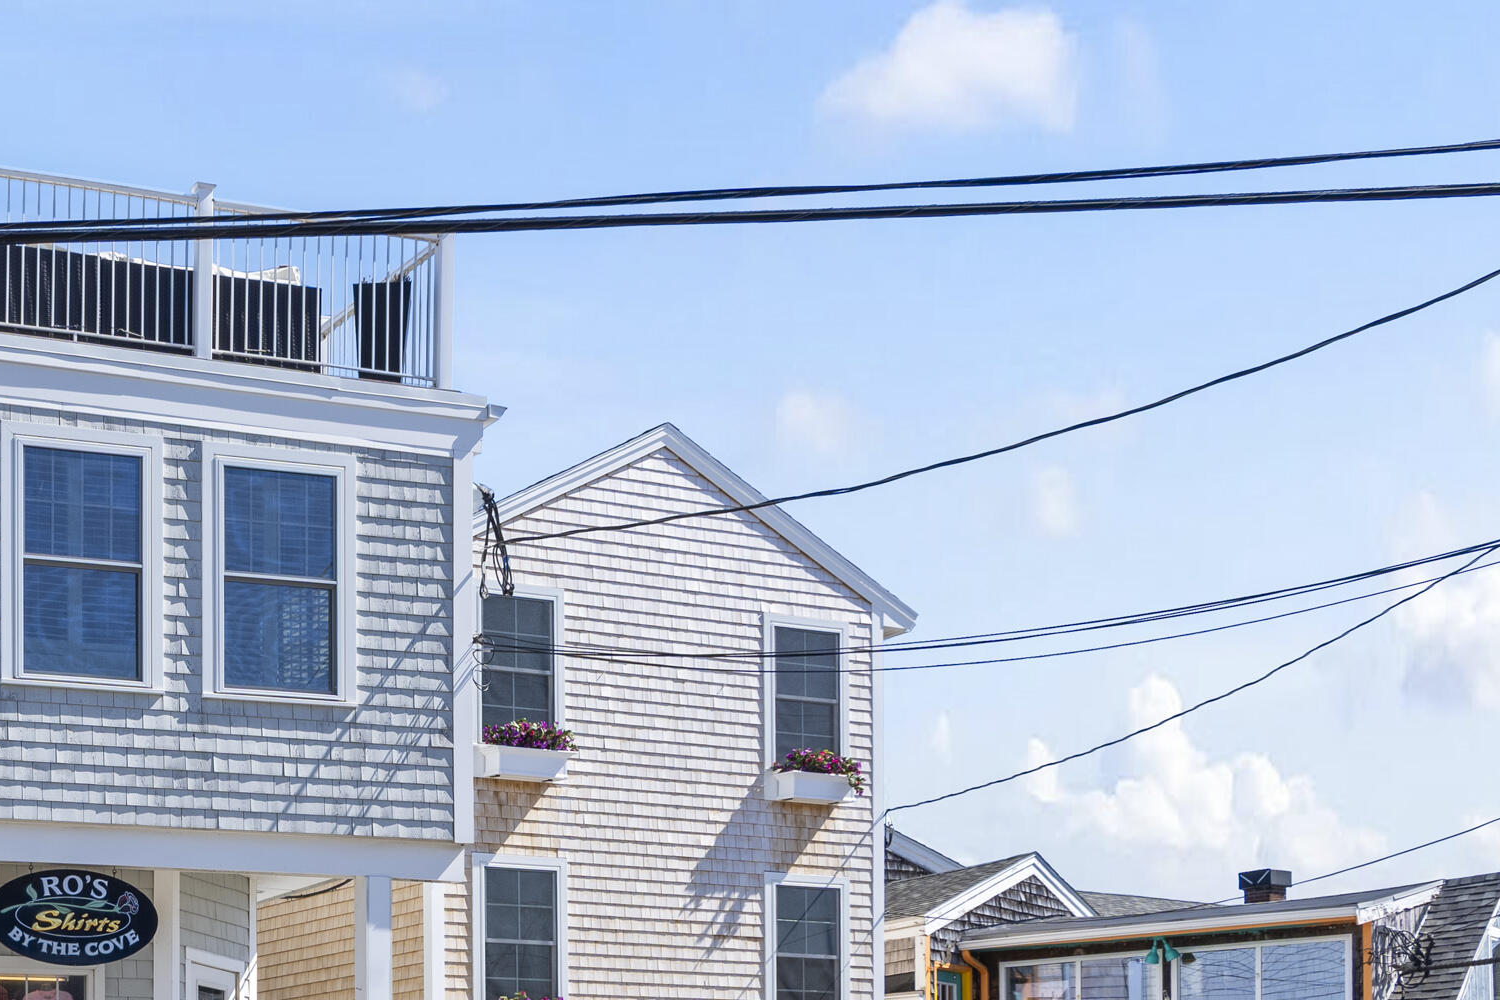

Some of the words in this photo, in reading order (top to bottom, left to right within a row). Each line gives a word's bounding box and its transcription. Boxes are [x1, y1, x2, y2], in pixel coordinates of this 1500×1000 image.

[40, 874, 109, 900] RO'S
[31, 909, 122, 934] Shirts
[7, 925, 37, 949] BY
[38, 937, 81, 956] THE
[84, 929, 140, 956] COVE
